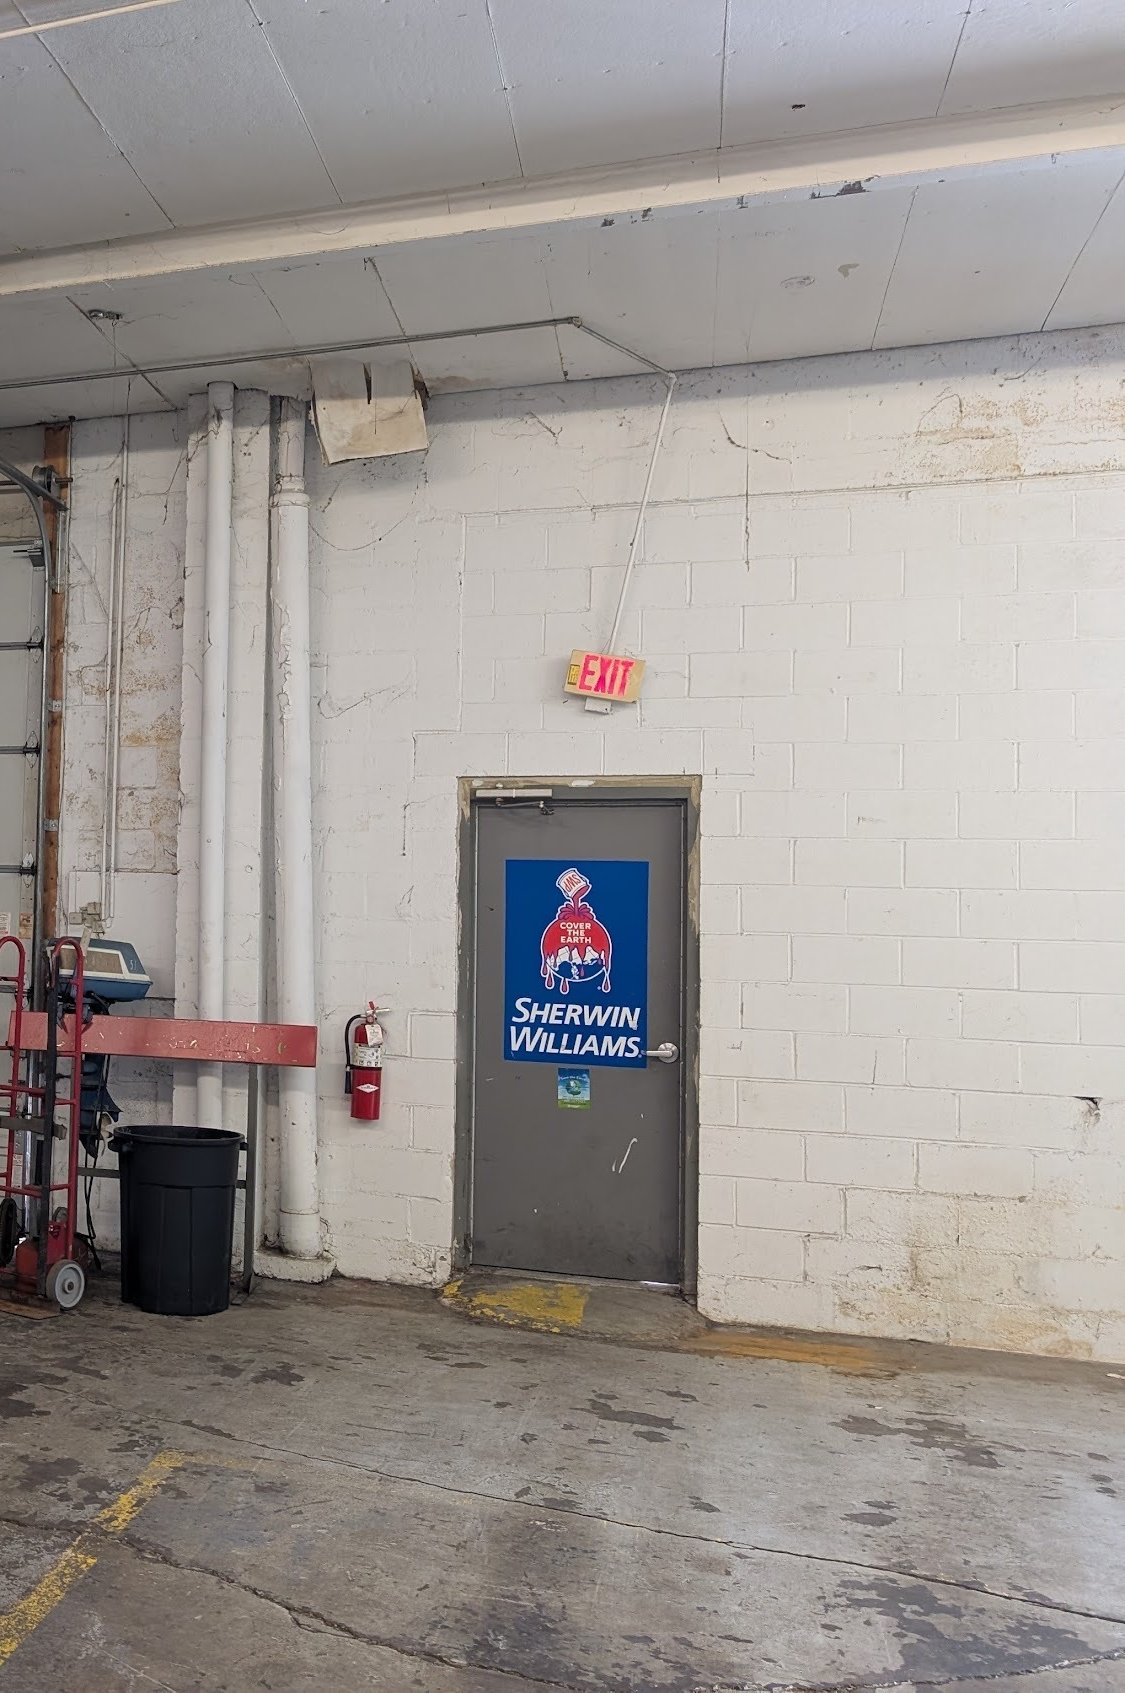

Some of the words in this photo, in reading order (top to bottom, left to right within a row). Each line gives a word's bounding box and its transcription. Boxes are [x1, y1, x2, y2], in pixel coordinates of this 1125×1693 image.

[578, 654, 635, 697] EXIT
[563, 873, 582, 893] SWP
[560, 922, 592, 930] COVER
[567, 929, 586, 937] THE
[560, 936, 592, 944] EARTH
[511, 997, 641, 1030] SHERWIN
[509, 1025, 641, 1058] WILLIAMS
